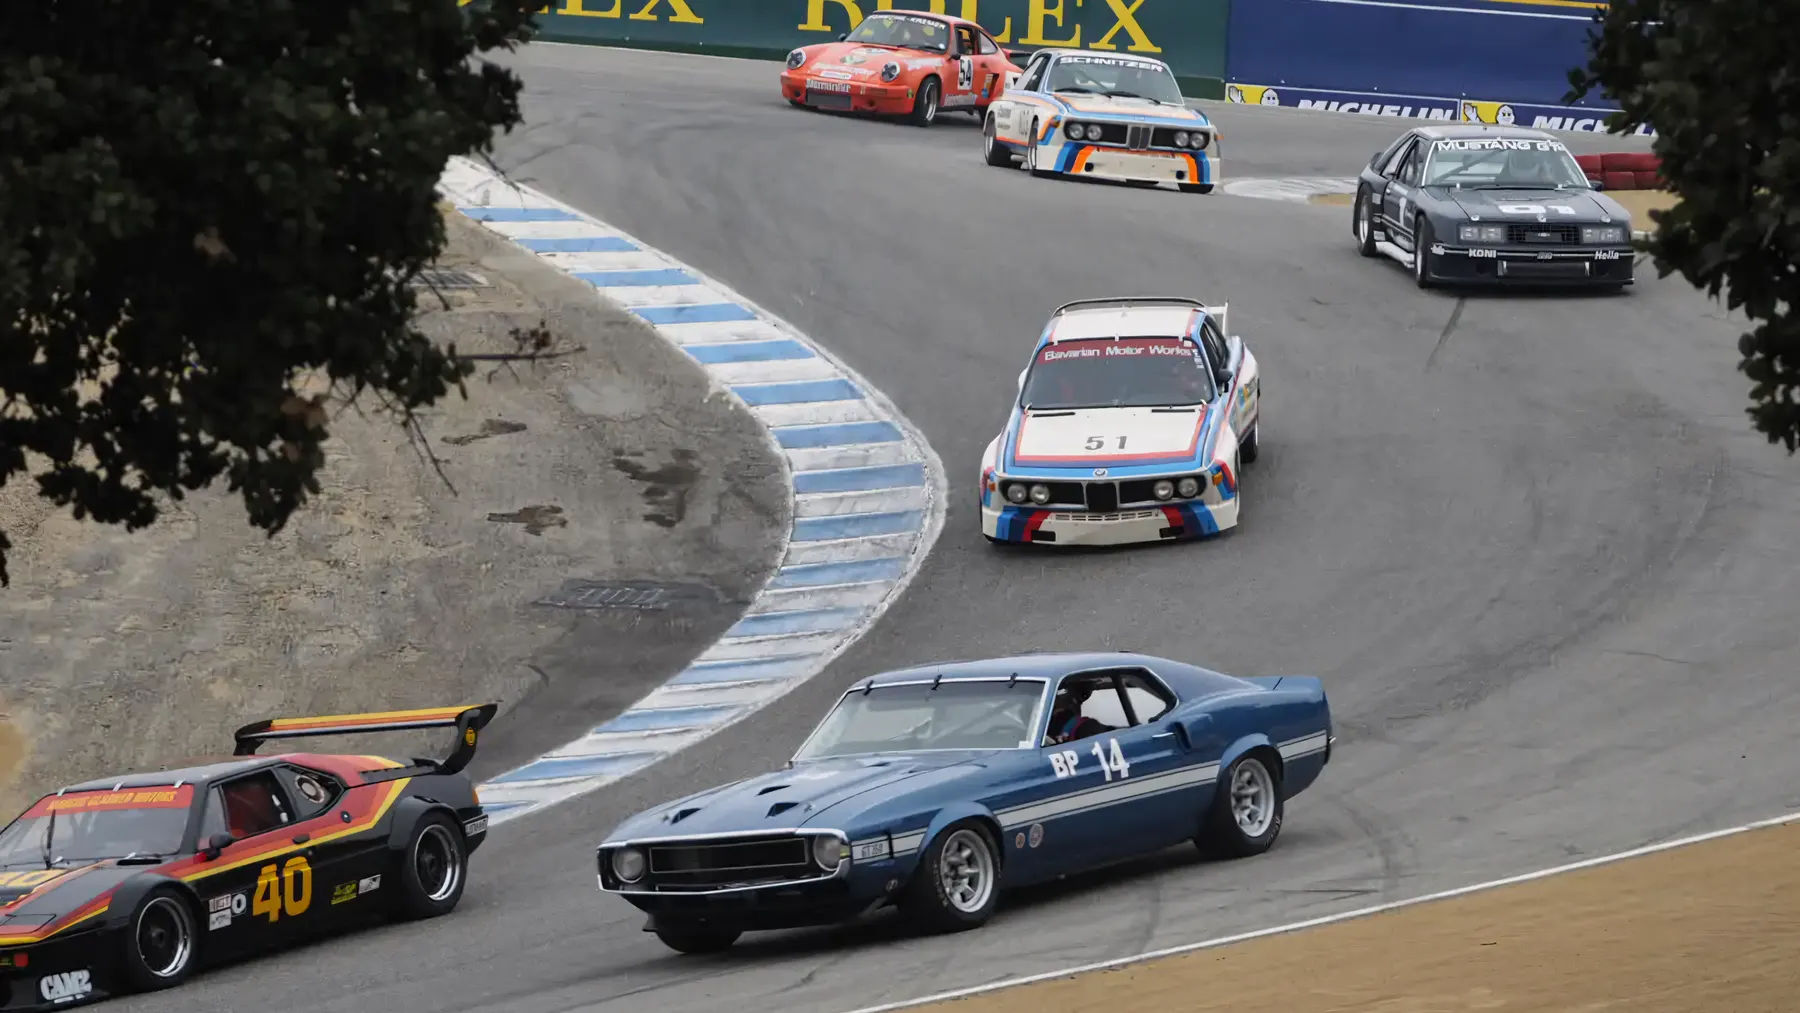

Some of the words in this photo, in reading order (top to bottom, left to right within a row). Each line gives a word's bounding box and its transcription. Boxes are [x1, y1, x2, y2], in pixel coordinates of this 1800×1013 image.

[798, 0, 1162, 52] RLEX
[959, 58, 972, 87] 54
[1060, 57, 1163, 72] SCHNITZER
[1437, 140, 1531, 151] MUSTANG
[1469, 248, 1497, 258] KONI
[1595, 250, 1619, 260] Hella
[1045, 348, 1100, 361] Bavarian
[1105, 346, 1145, 356] Motor
[1149, 345, 1192, 356] Works
[1048, 750, 1079, 778] BP
[1091, 738, 1130, 781] 14
[252, 856, 313, 923] 40
